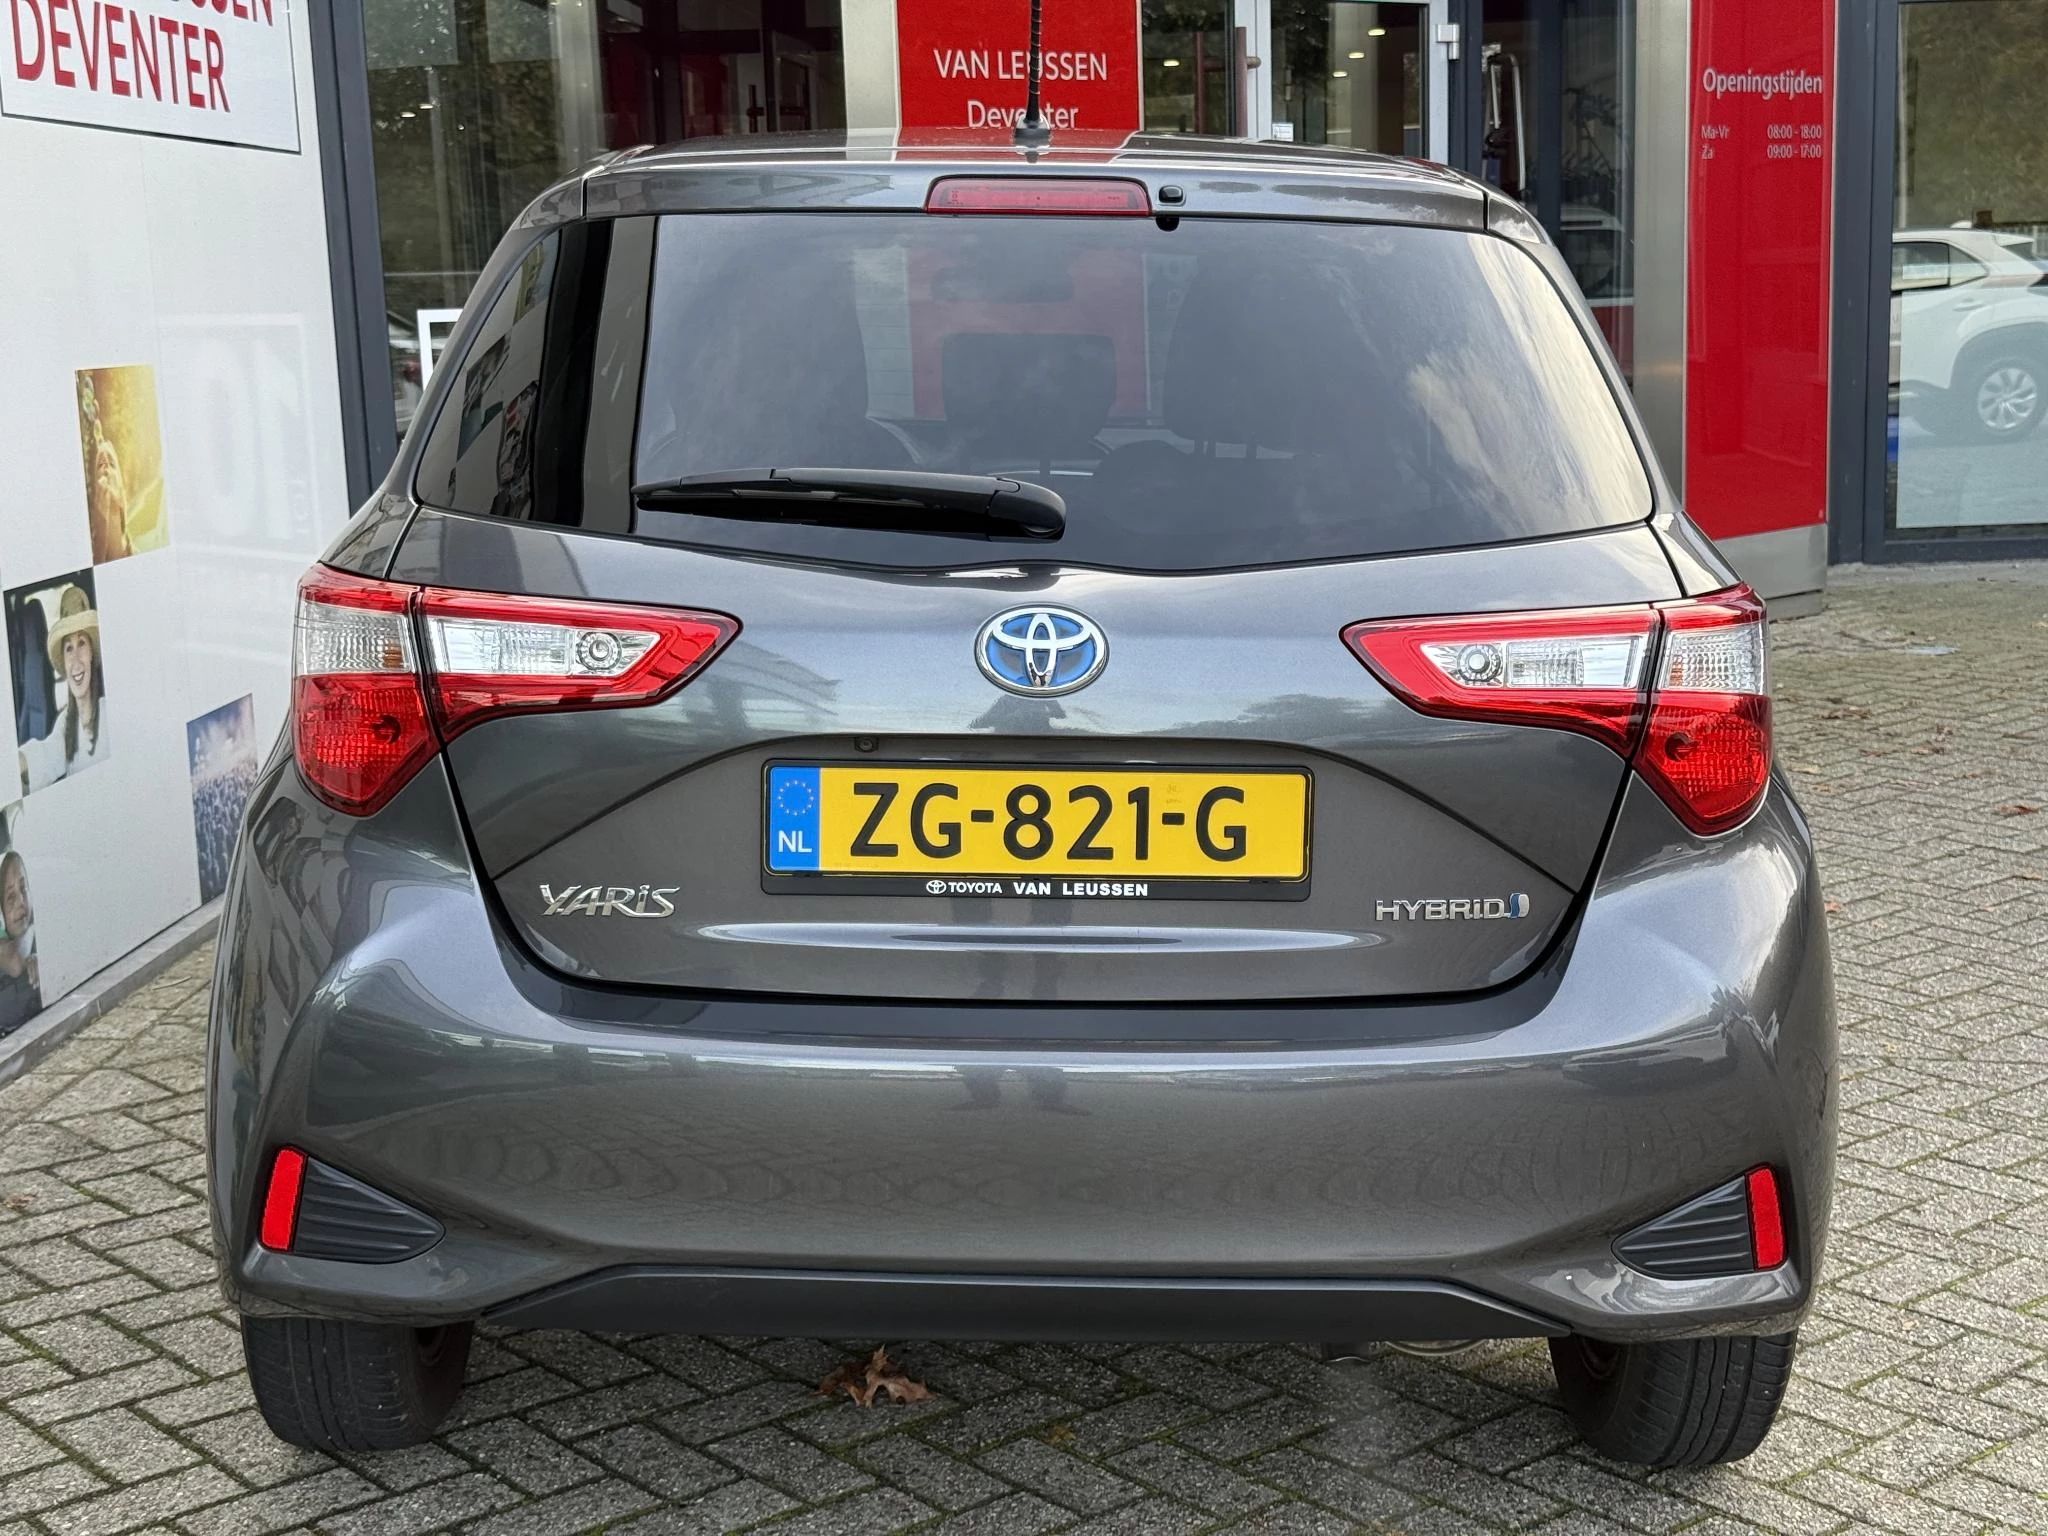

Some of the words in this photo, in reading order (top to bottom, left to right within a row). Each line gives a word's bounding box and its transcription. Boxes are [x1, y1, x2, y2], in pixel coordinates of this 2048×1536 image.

[11, 0, 231, 113] DEVENTER
[933, 49, 990, 79] VAN
[1702, 67, 1823, 100] Openingstijden
[967, 100, 1079, 129] Deveter
[1767, 124, 1793, 139] 08:00
[1800, 124, 1822, 139] 18:00
[1767, 144, 1793, 159] 09:00
[1800, 144, 1822, 159] 17:00
[778, 830, 813, 853] NL
[850, 782, 1248, 861] ZG-821-G
[949, 882, 1003, 894] TOYOTA
[1013, 882, 1051, 895] VAN
[1062, 883, 1148, 897] LEUSSEN
